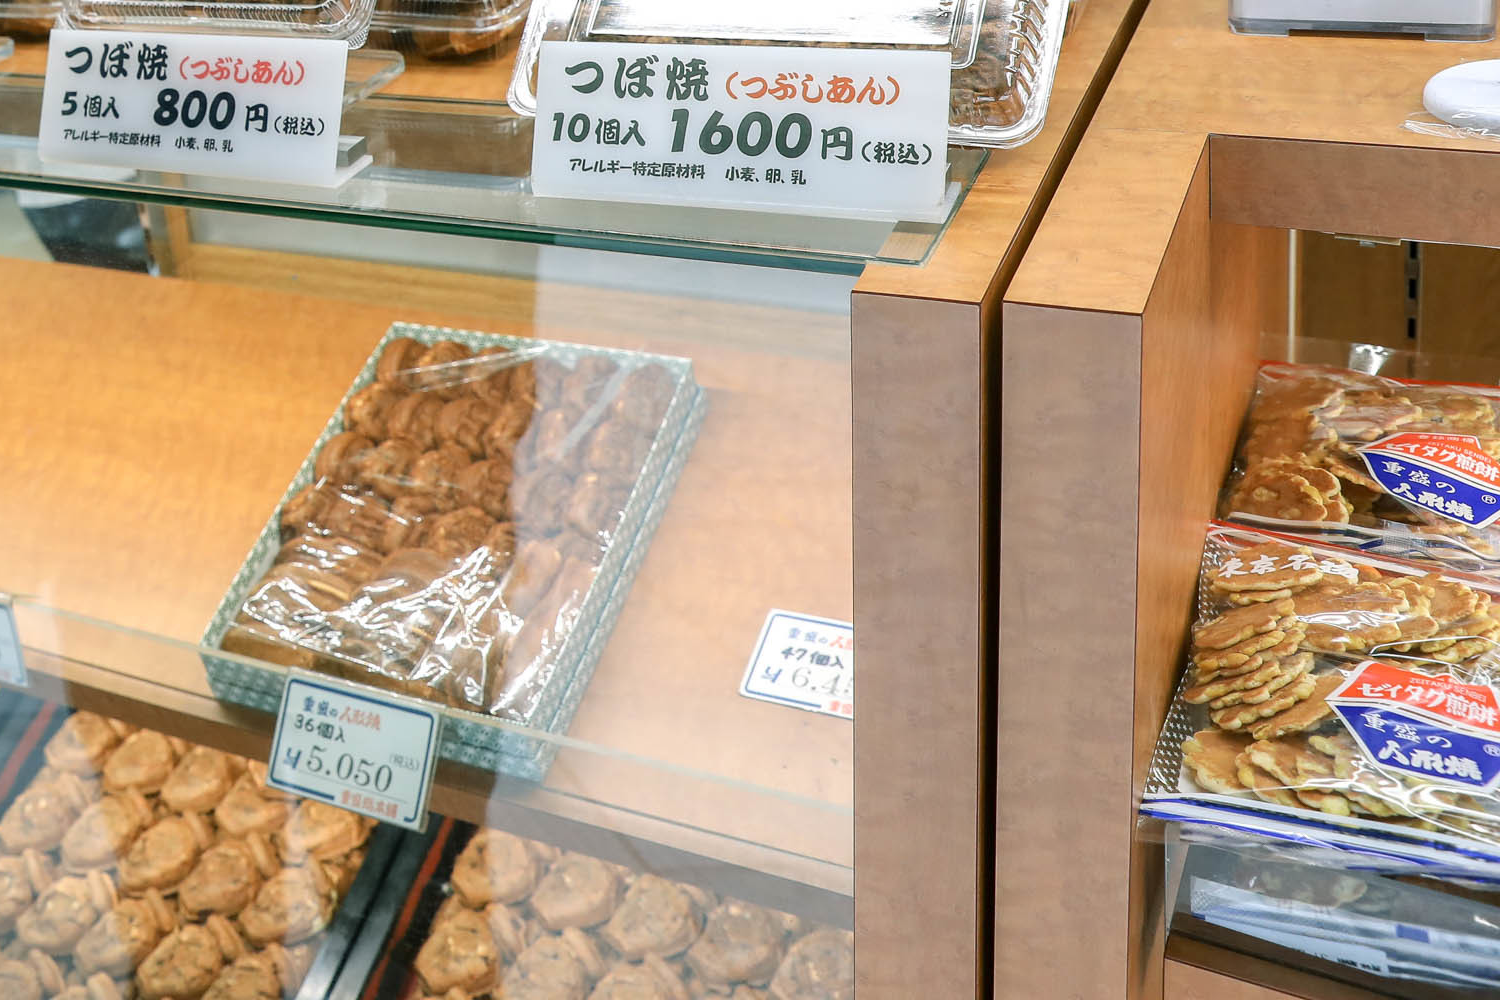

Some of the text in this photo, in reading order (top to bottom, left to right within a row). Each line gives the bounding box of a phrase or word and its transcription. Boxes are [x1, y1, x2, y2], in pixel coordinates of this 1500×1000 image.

[65, 41, 305, 86] つぼ焼 （つぶしあん）
[564, 55, 901, 105] つぼ焼 （つぶしあん）
[61, 88, 325, 136] 5個入 800円 （税込）
[64, 129, 233, 152] アレルギー特定原材料 小麦、卵、乳
[552, 108, 933, 165] 10個入 1600円 （税込）
[569, 158, 807, 185] アレルギー特定原材料 小麦、卵、乳
[1381, 461, 1456, 494] 重盛の
[1357, 683, 1499, 726] ゼイタク煎餅
[294, 713, 345, 743] 36個入
[1360, 712, 1452, 748] 重盛の
